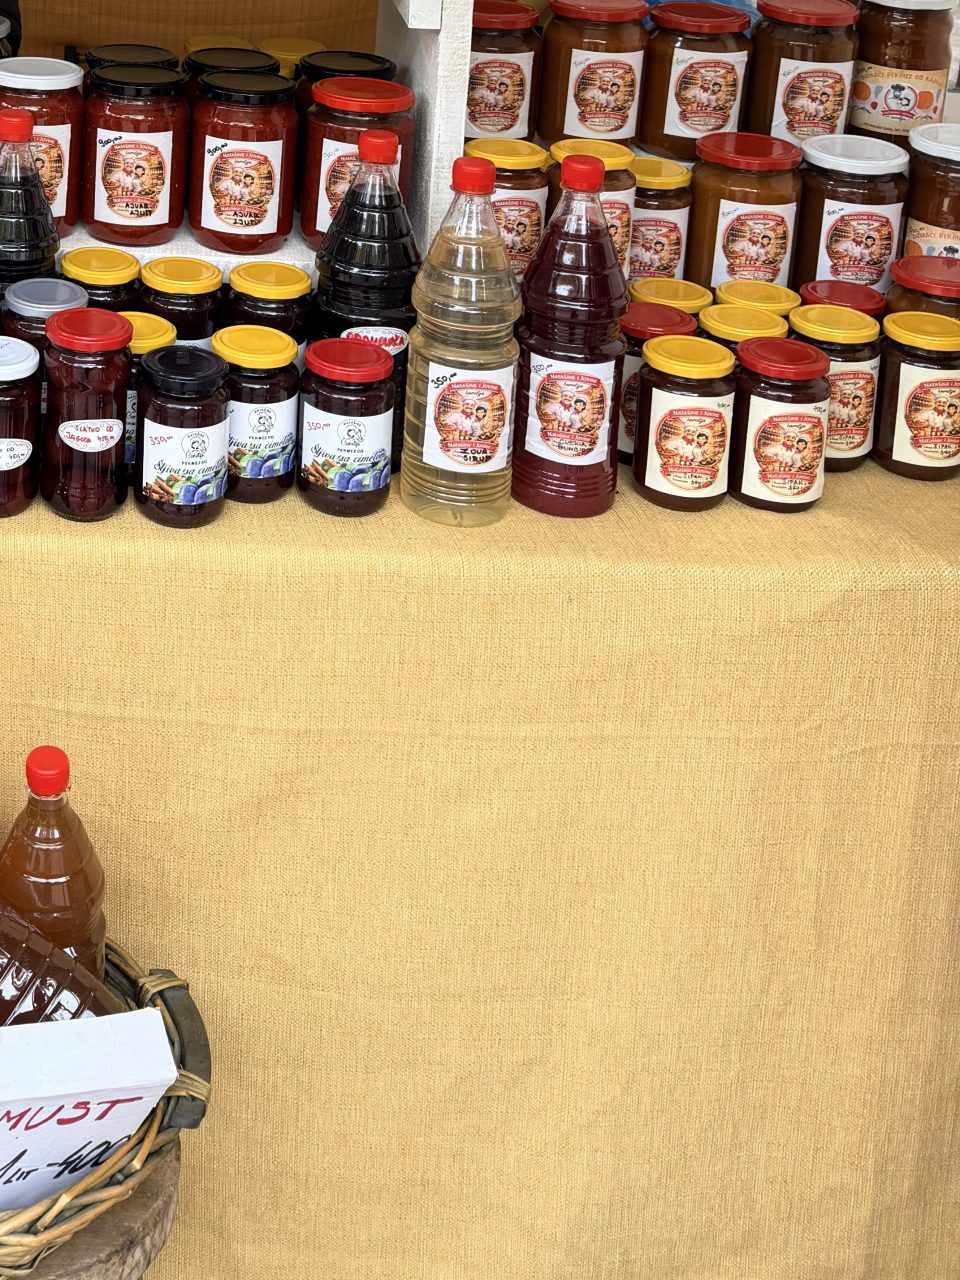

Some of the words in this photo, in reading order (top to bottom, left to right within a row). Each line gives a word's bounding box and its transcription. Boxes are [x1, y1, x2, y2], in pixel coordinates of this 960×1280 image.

[532, 364, 553, 373] 350,00
[431, 373, 457, 389] 350,00
[75, 425, 100, 433] SLATKO
[307, 421, 331, 431] 350,00
[149, 435, 174, 446] 350,00
[229, 435, 248, 449] ljiva
